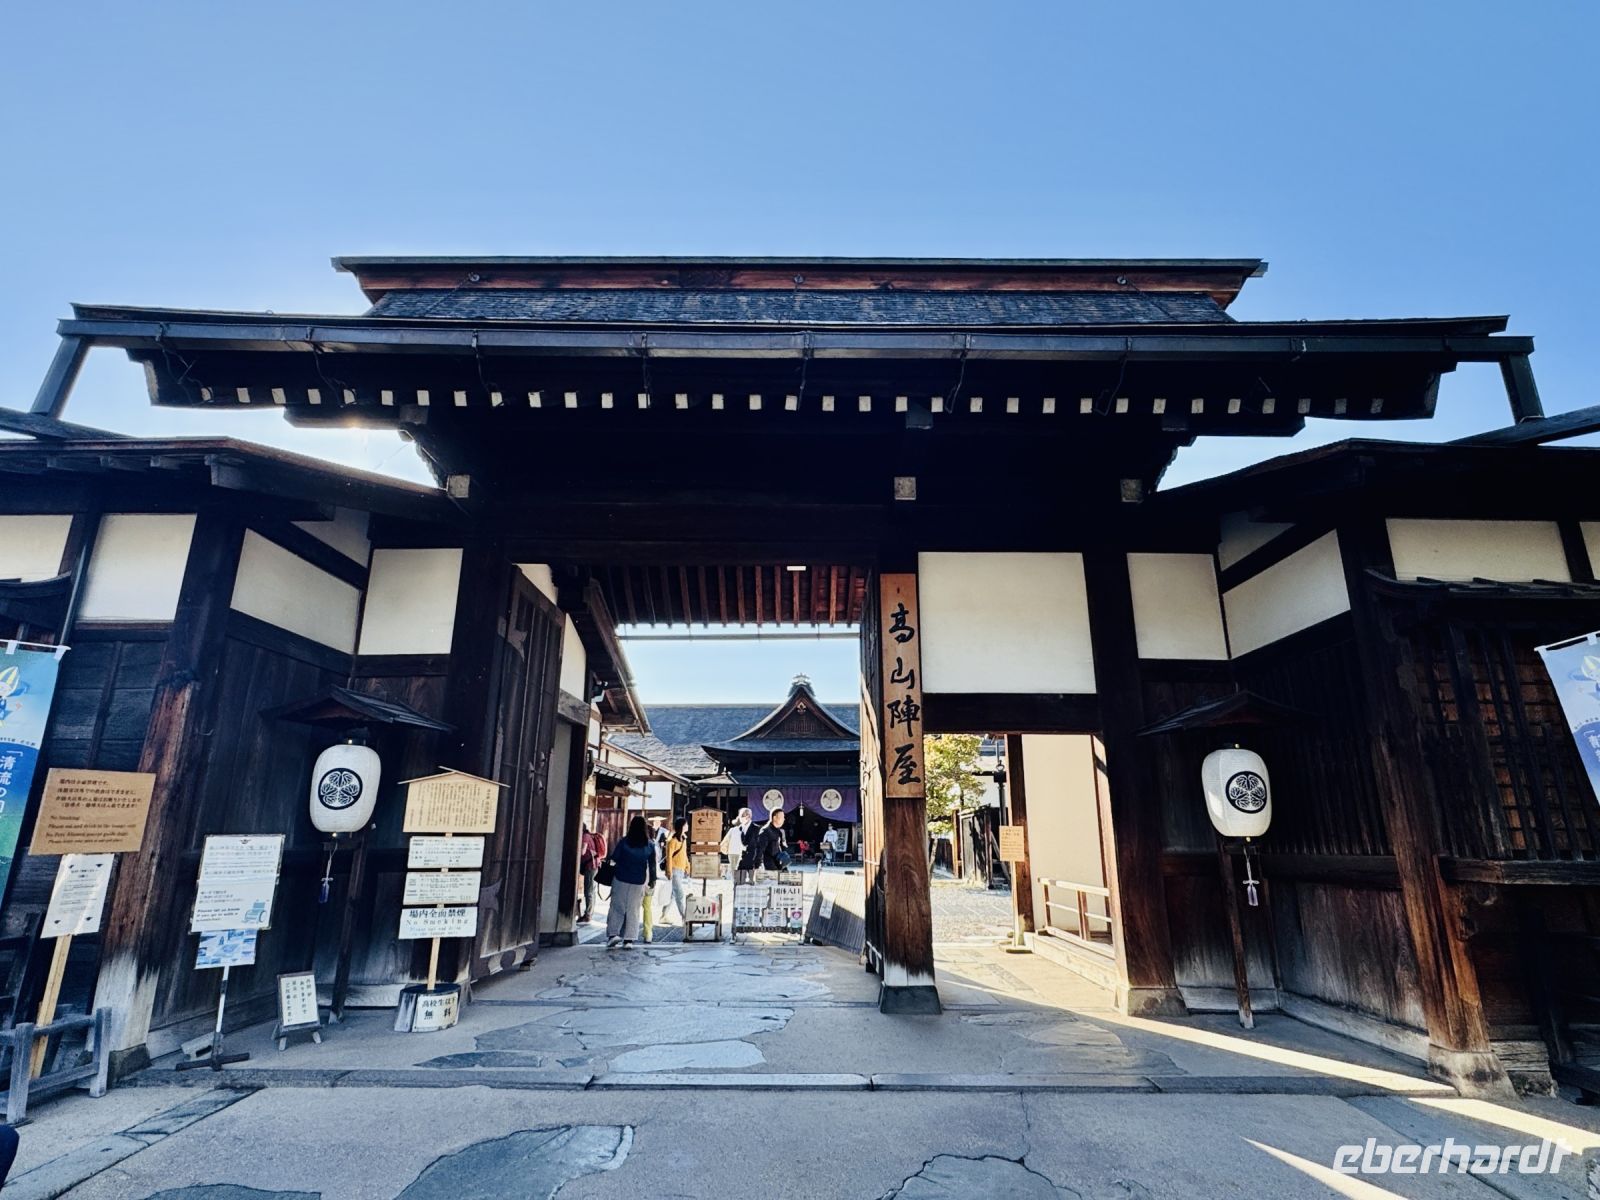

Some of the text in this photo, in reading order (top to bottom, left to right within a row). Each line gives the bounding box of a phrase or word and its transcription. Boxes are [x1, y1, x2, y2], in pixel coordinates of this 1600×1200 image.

[887, 603, 921, 785] 高山陣屋
[409, 909, 466, 918] 場内全面禁煙
